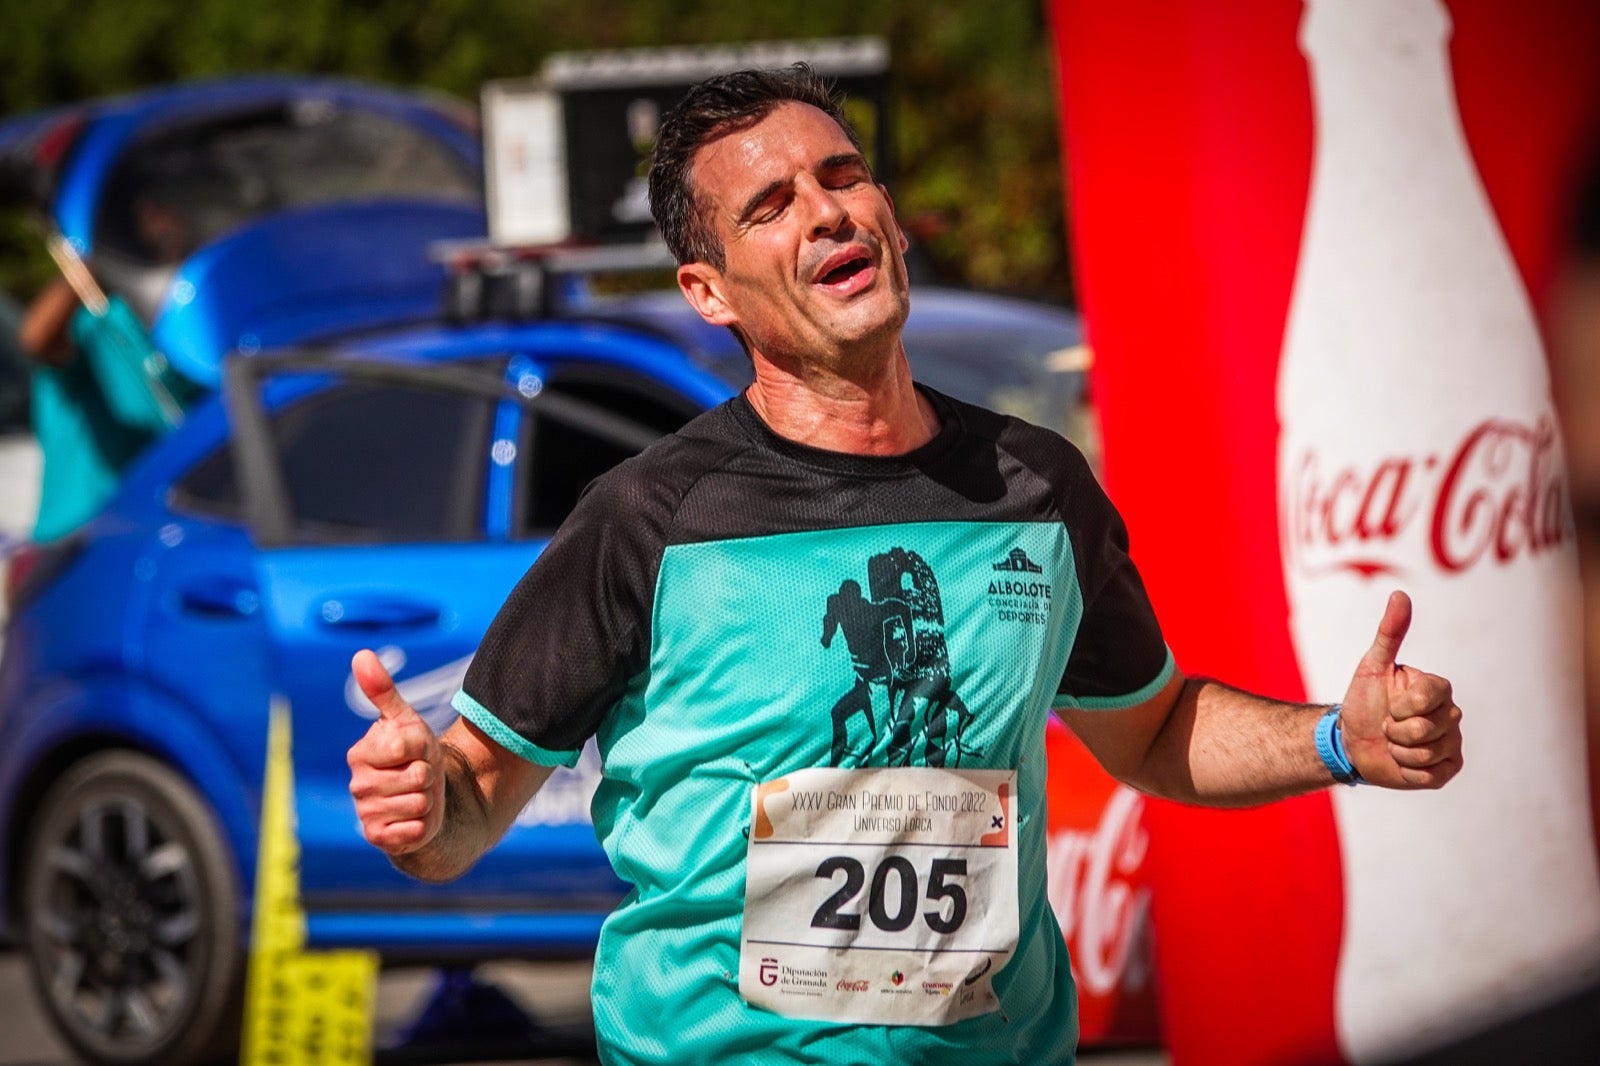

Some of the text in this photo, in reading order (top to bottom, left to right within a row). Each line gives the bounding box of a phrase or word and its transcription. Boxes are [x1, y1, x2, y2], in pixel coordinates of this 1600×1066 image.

[988, 580, 1051, 599] ALBOLOTE
[998, 609, 1046, 625] DEPORTES
[791, 790, 987, 813] XXXV GRAN PREMIO DE FONDO 2022
[854, 814, 932, 832] UNIVERSO LORCA
[810, 855, 967, 934] 205
[781, 965, 828, 978] Diputación
[780, 976, 827, 987] de Granada
